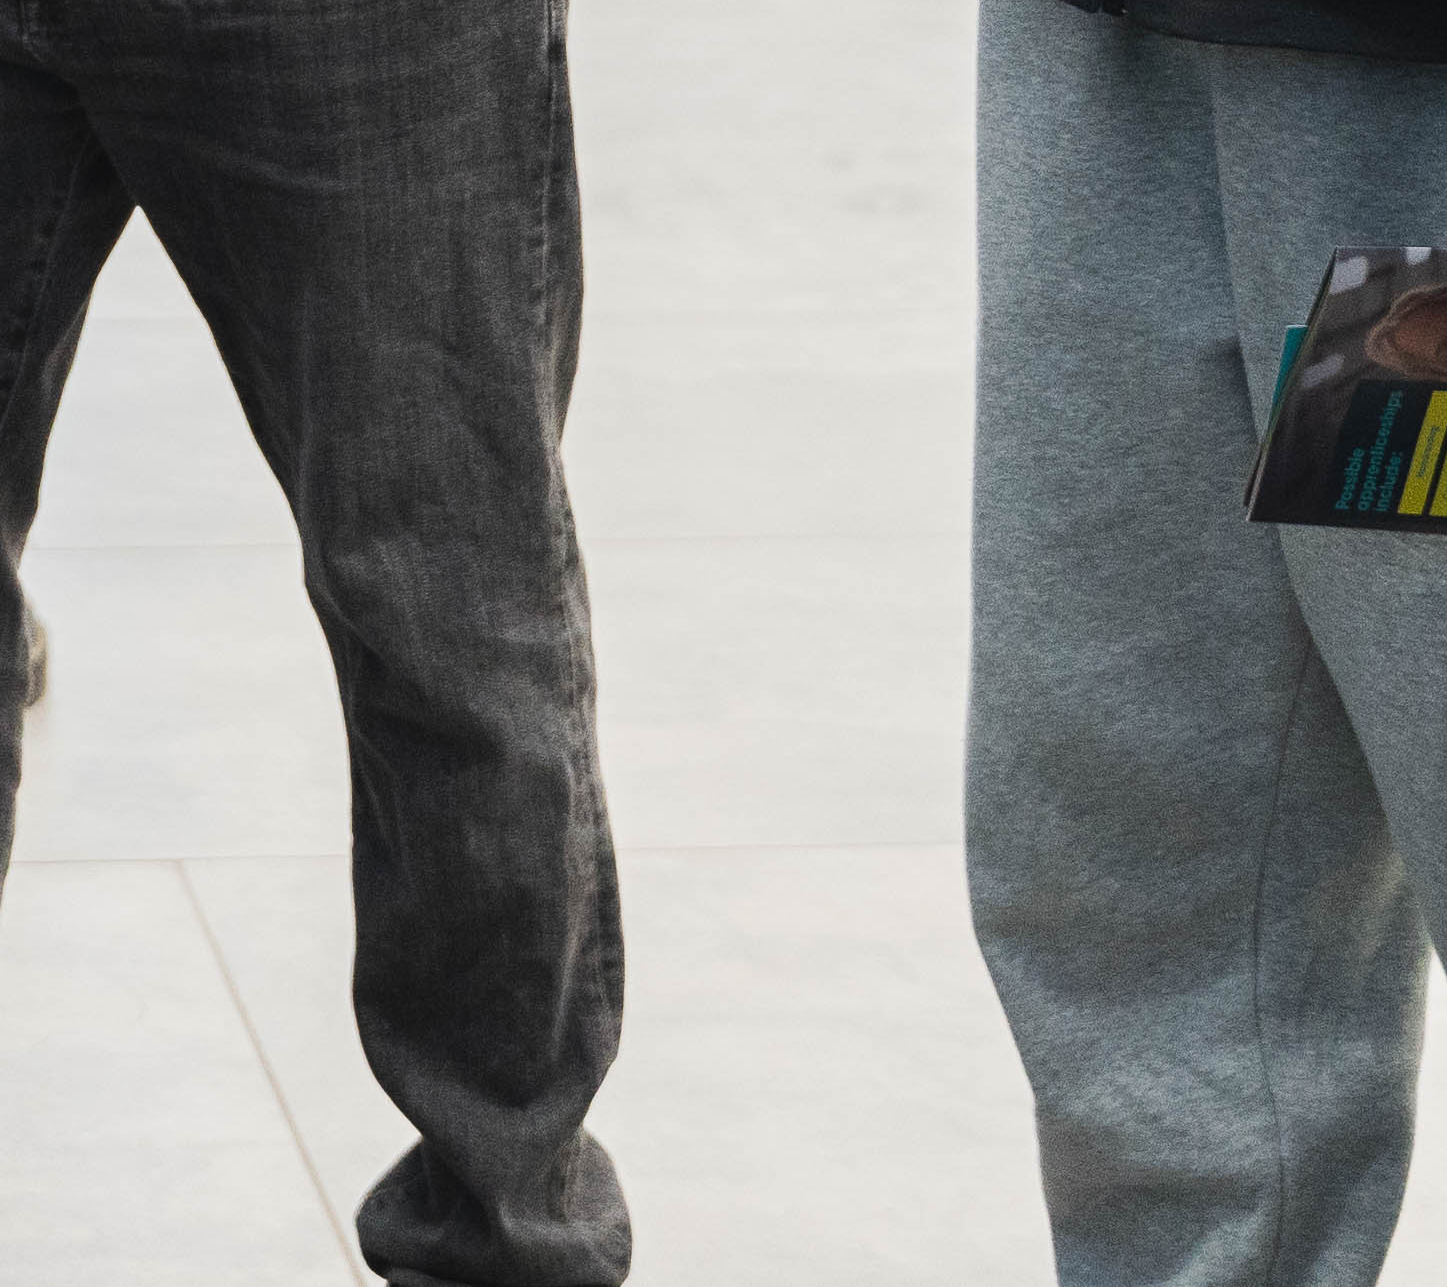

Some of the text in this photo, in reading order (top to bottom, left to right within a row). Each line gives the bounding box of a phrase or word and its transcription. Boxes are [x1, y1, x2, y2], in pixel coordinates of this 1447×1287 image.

[1335, 447, 1364, 510] Possible
[1358, 390, 1403, 511] apprenticeships
[1375, 451, 1403, 511] include:
